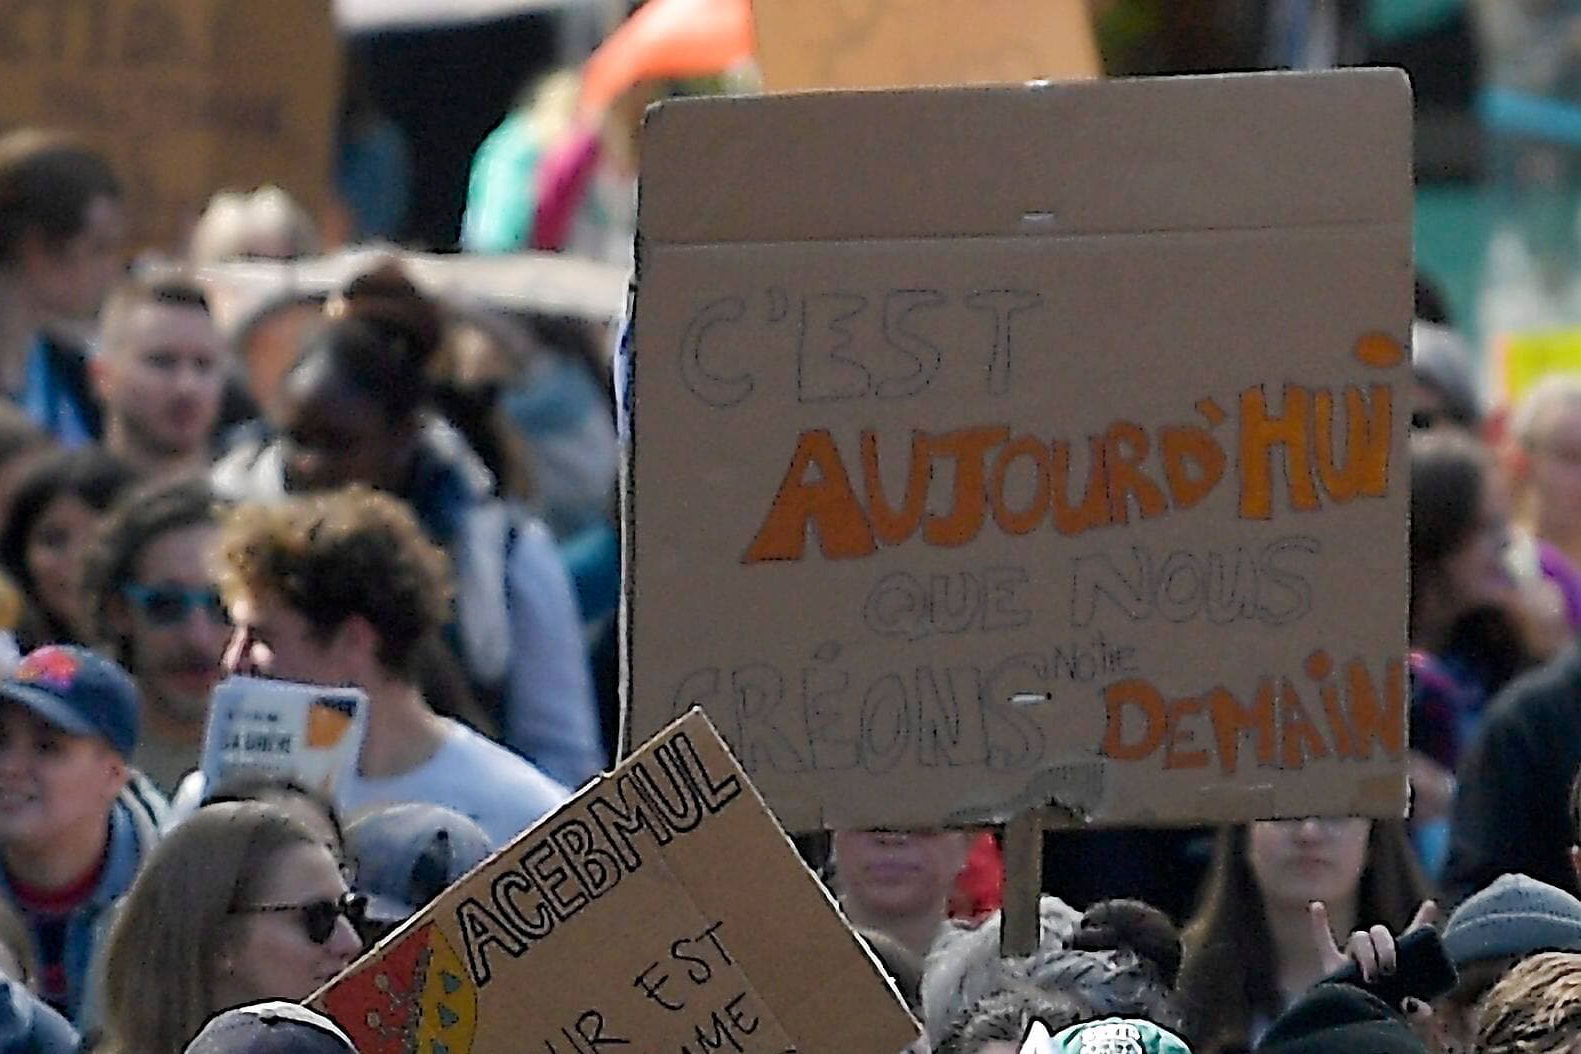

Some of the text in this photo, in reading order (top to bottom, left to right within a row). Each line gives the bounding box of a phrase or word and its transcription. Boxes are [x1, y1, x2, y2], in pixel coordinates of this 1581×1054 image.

[679, 286, 1044, 408] C'EST
[864, 534, 1318, 641] QUE NOUS
[456, 732, 742, 988] ACEBMUL
[633, 920, 737, 1032] EST
